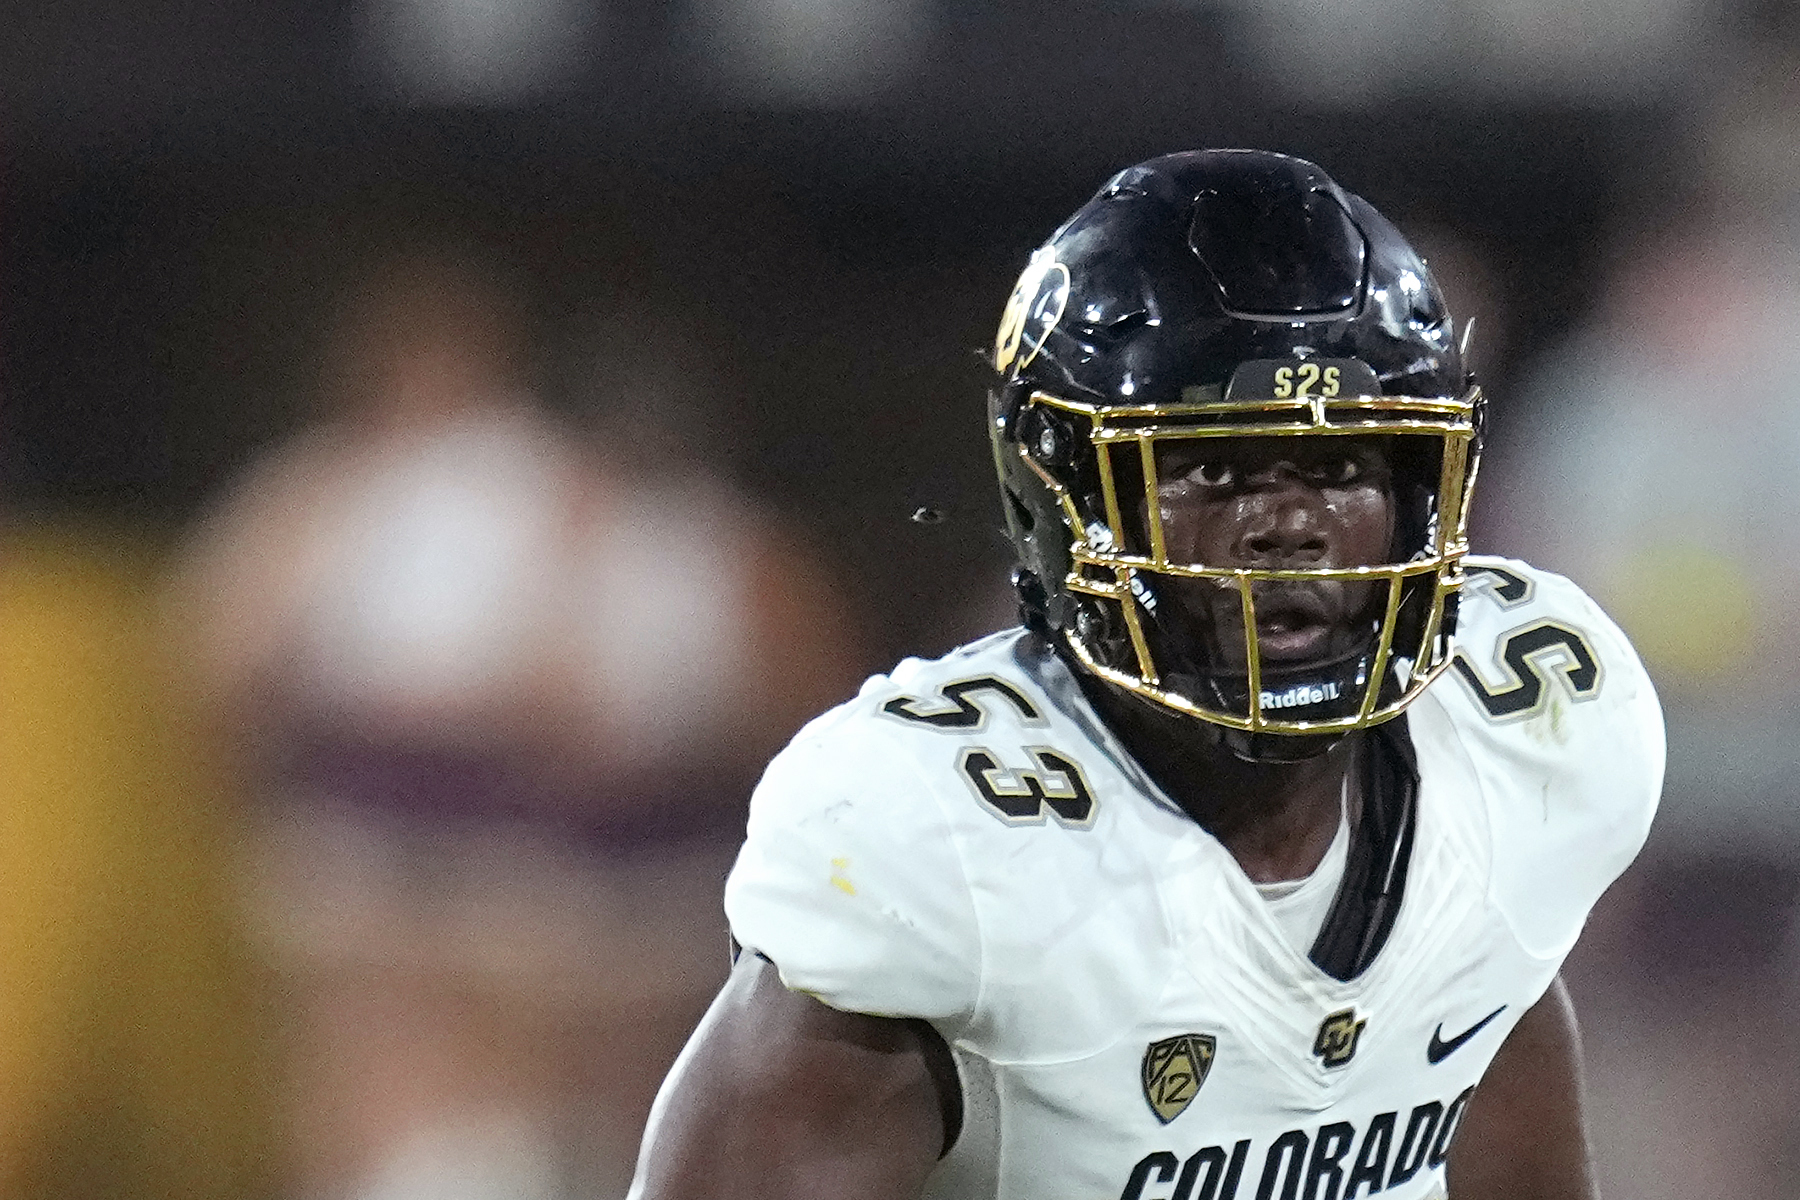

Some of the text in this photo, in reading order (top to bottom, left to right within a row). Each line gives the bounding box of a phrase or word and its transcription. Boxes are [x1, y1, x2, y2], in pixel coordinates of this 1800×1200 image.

[1259, 682, 1340, 710] Riddell
[871, 672, 1101, 831] 53
[1156, 1071, 1193, 1106] 12
